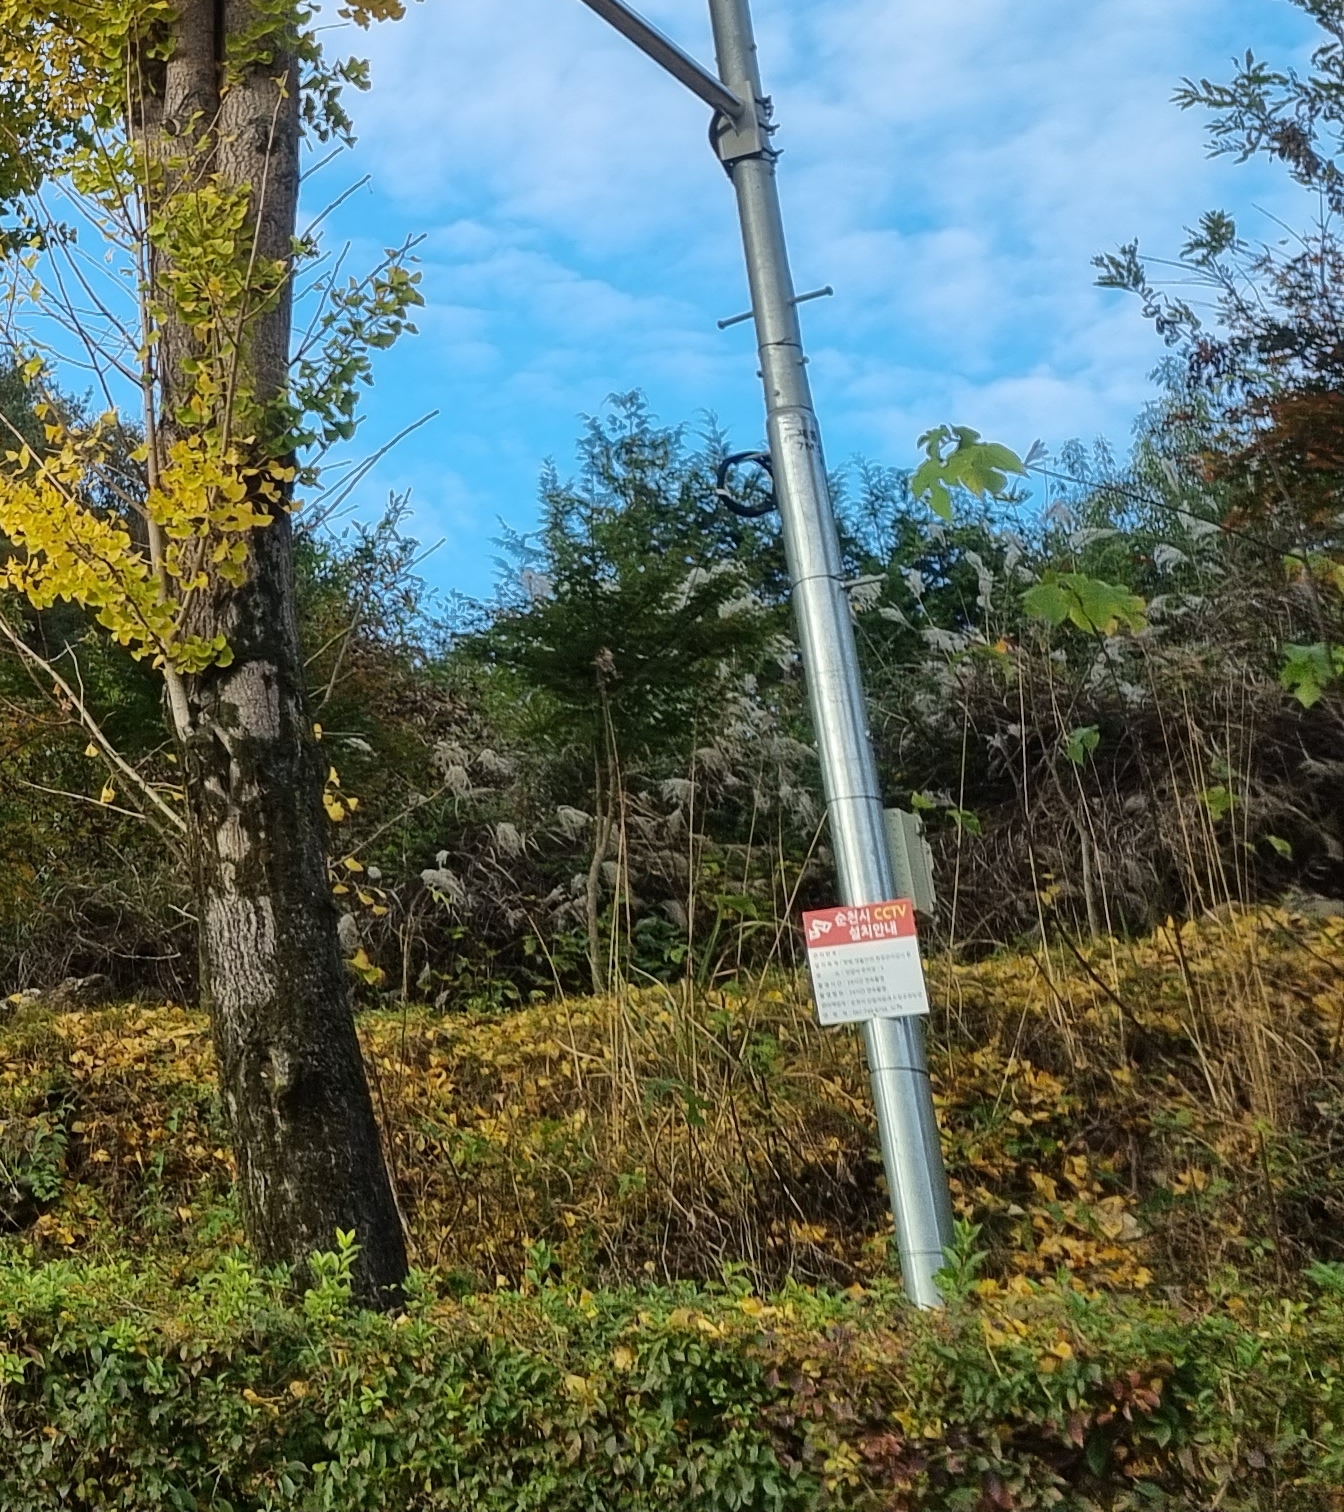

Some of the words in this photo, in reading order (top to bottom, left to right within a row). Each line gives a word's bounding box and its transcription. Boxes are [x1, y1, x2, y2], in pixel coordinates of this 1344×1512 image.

[835, 908, 870, 927] 순천시
[874, 904, 906, 921] CCTV
[849, 920, 898, 942] 설치안내
